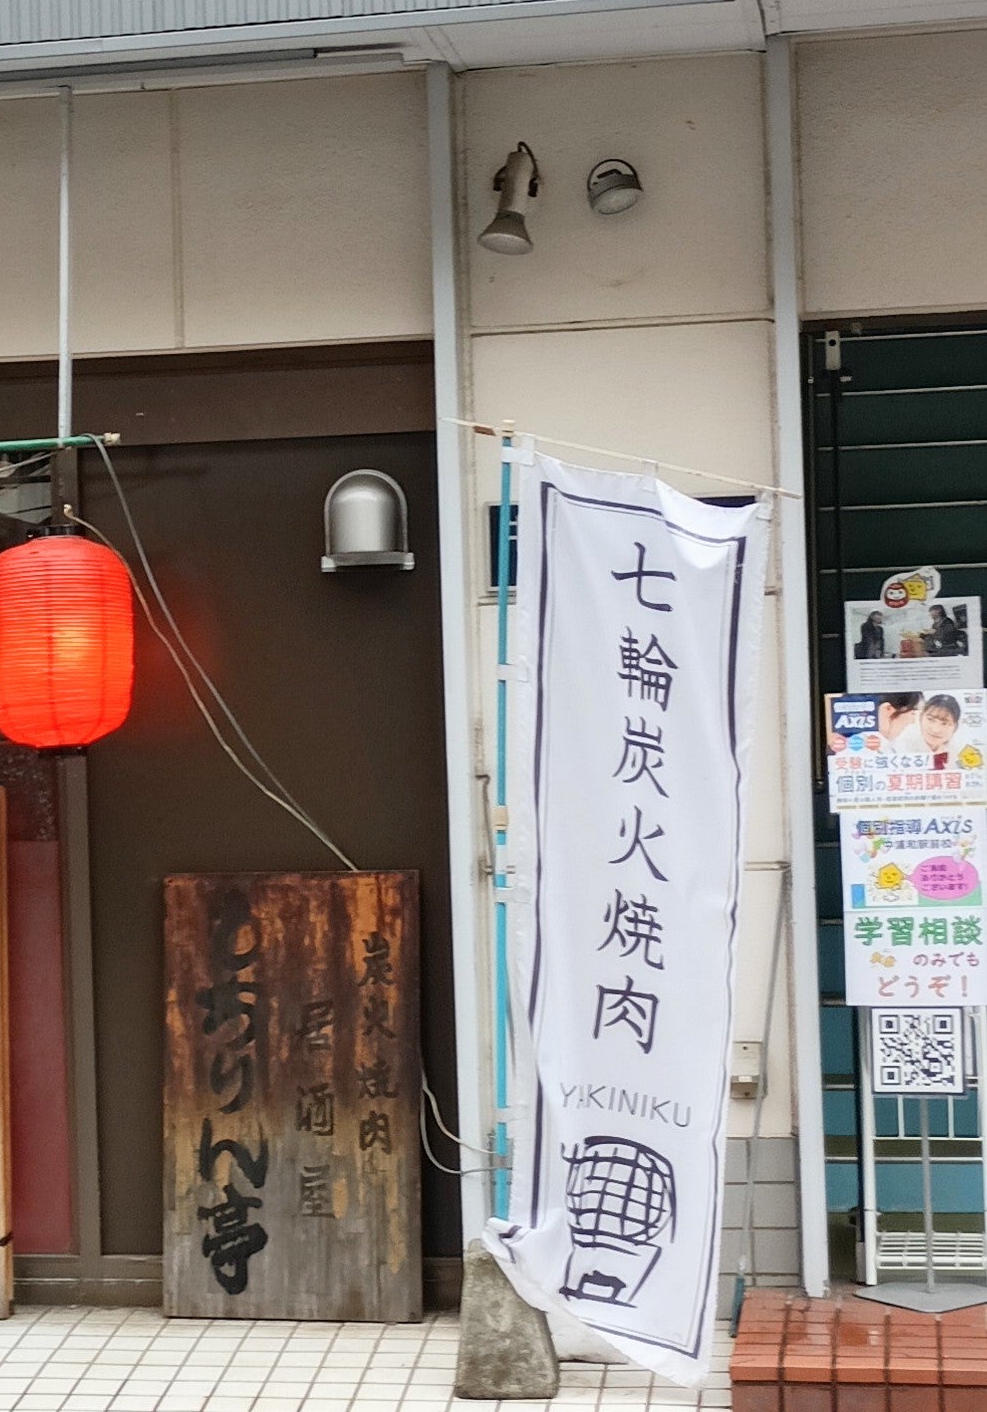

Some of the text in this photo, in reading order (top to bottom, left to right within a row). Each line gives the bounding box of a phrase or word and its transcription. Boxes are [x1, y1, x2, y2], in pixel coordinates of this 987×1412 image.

[592, 541, 680, 1055] 七輪炭火焼肉
[836, 772, 962, 794] 個別の夏期講習
[923, 817, 974, 835] Axis
[853, 915, 983, 947] 学習相談
[357, 930, 399, 1156] 炭火焼肉
[293, 1000, 336, 1220] 居酒屋
